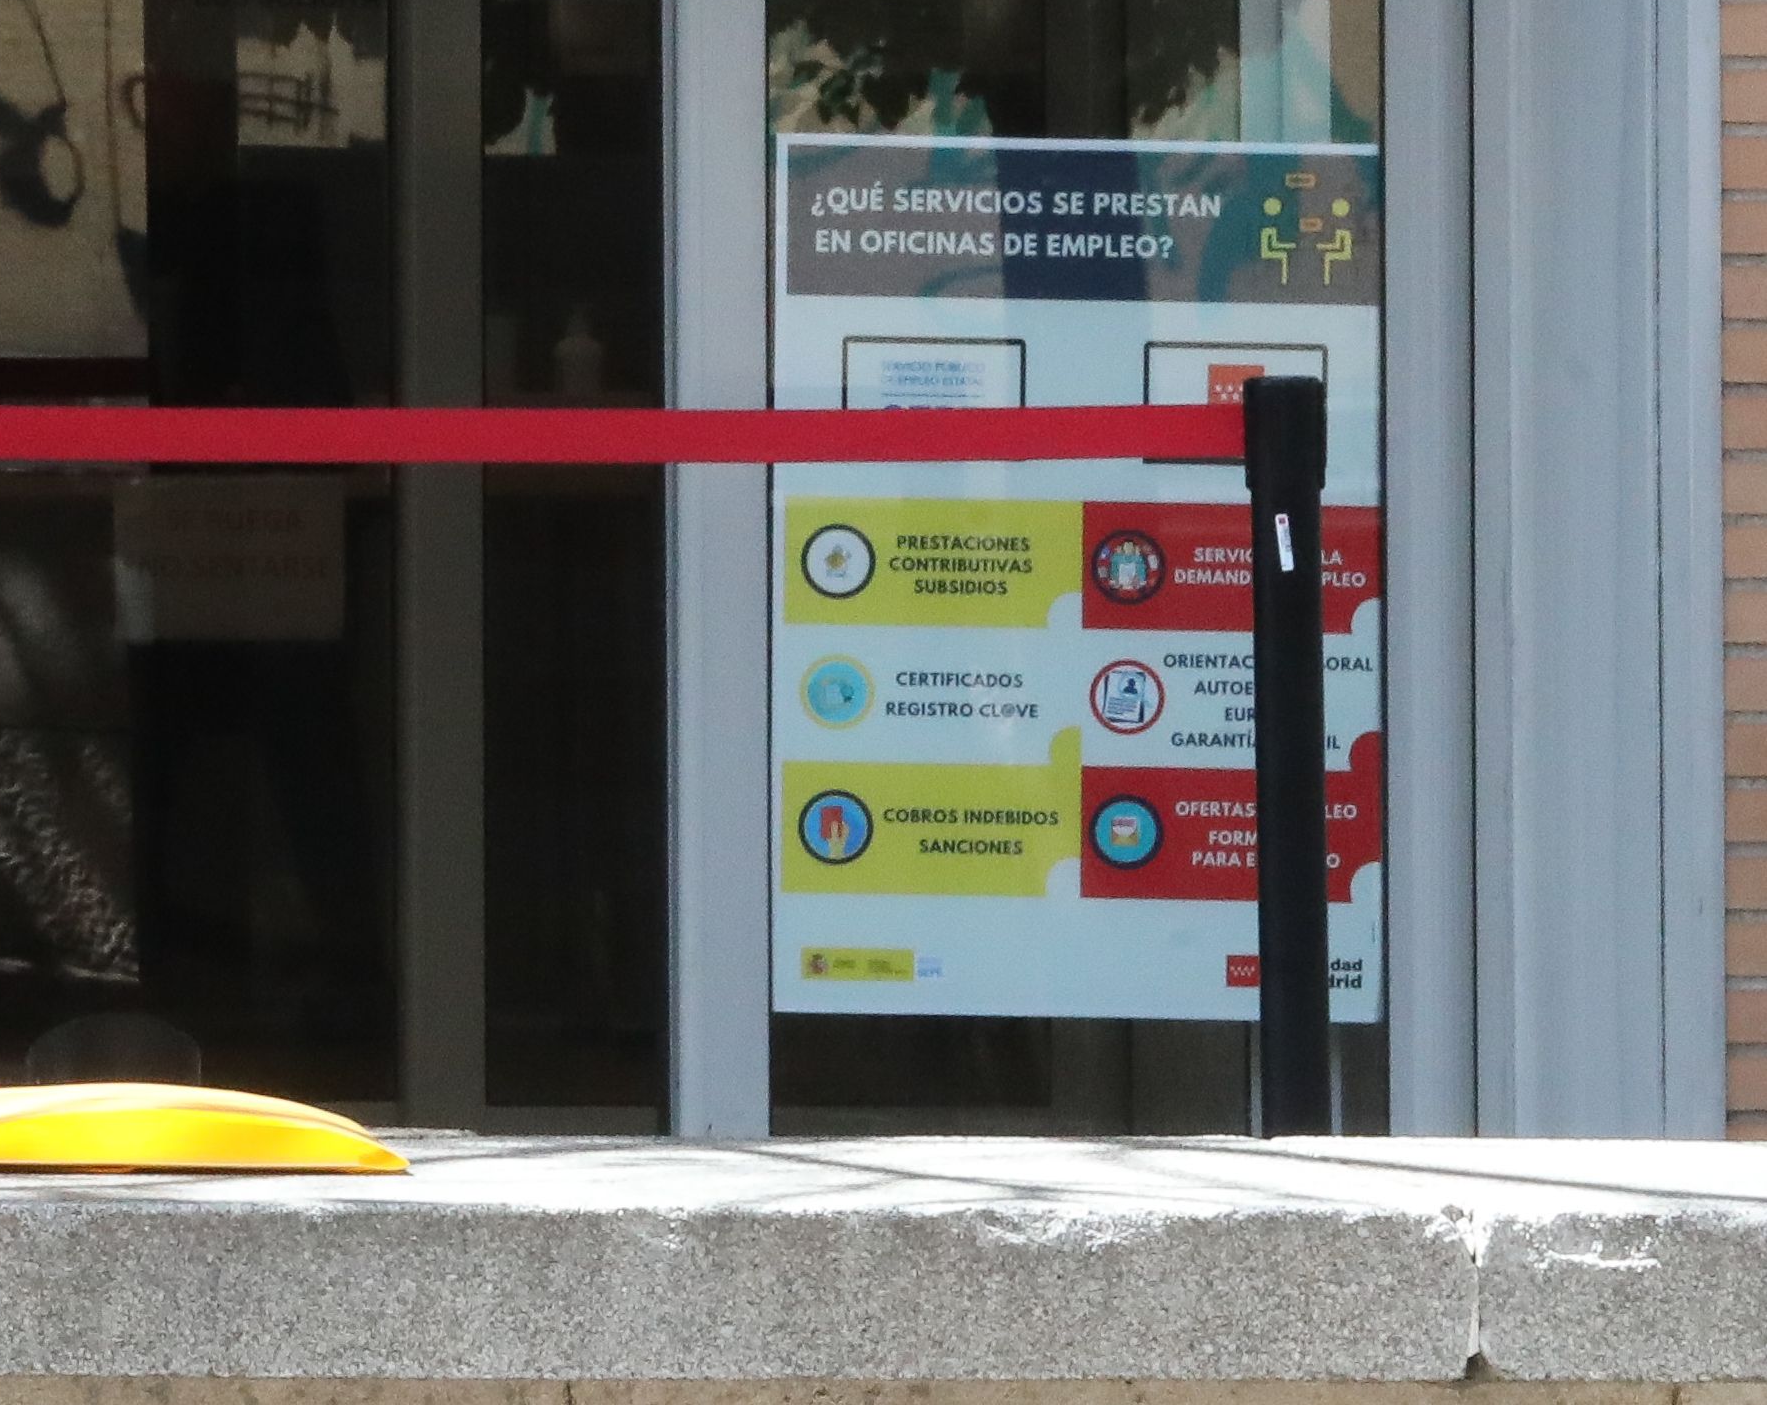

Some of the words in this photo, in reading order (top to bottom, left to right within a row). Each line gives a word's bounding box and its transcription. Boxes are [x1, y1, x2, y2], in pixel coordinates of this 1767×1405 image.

[810, 179, 885, 217] ¿QUÉ
[892, 188, 1044, 215] SERVICIOS
[1052, 190, 1085, 216] SE
[1093, 191, 1222, 219] PRESTAN
[815, 228, 852, 254] EN
[859, 229, 996, 257] OFICINAS
[1003, 232, 1038, 257] DE
[1046, 233, 1175, 260] EMPLEO?
[896, 535, 1032, 553] PRESTACIONES
[888, 557, 1034, 575] CONTRIBUTIVAS
[914, 579, 1010, 596] SUBSIDIOS
[895, 671, 1025, 689] CERTIFICADOS
[885, 701, 974, 717] REGISTRO
[1170, 729, 1256, 748] GARANTÍ
[882, 807, 959, 825] COBROS
[963, 809, 1060, 827] INDEBIDOS
[1175, 800, 1258, 817] OFERTAS
[919, 838, 1025, 856] SANCIONES
[1191, 850, 1242, 868] PARA
